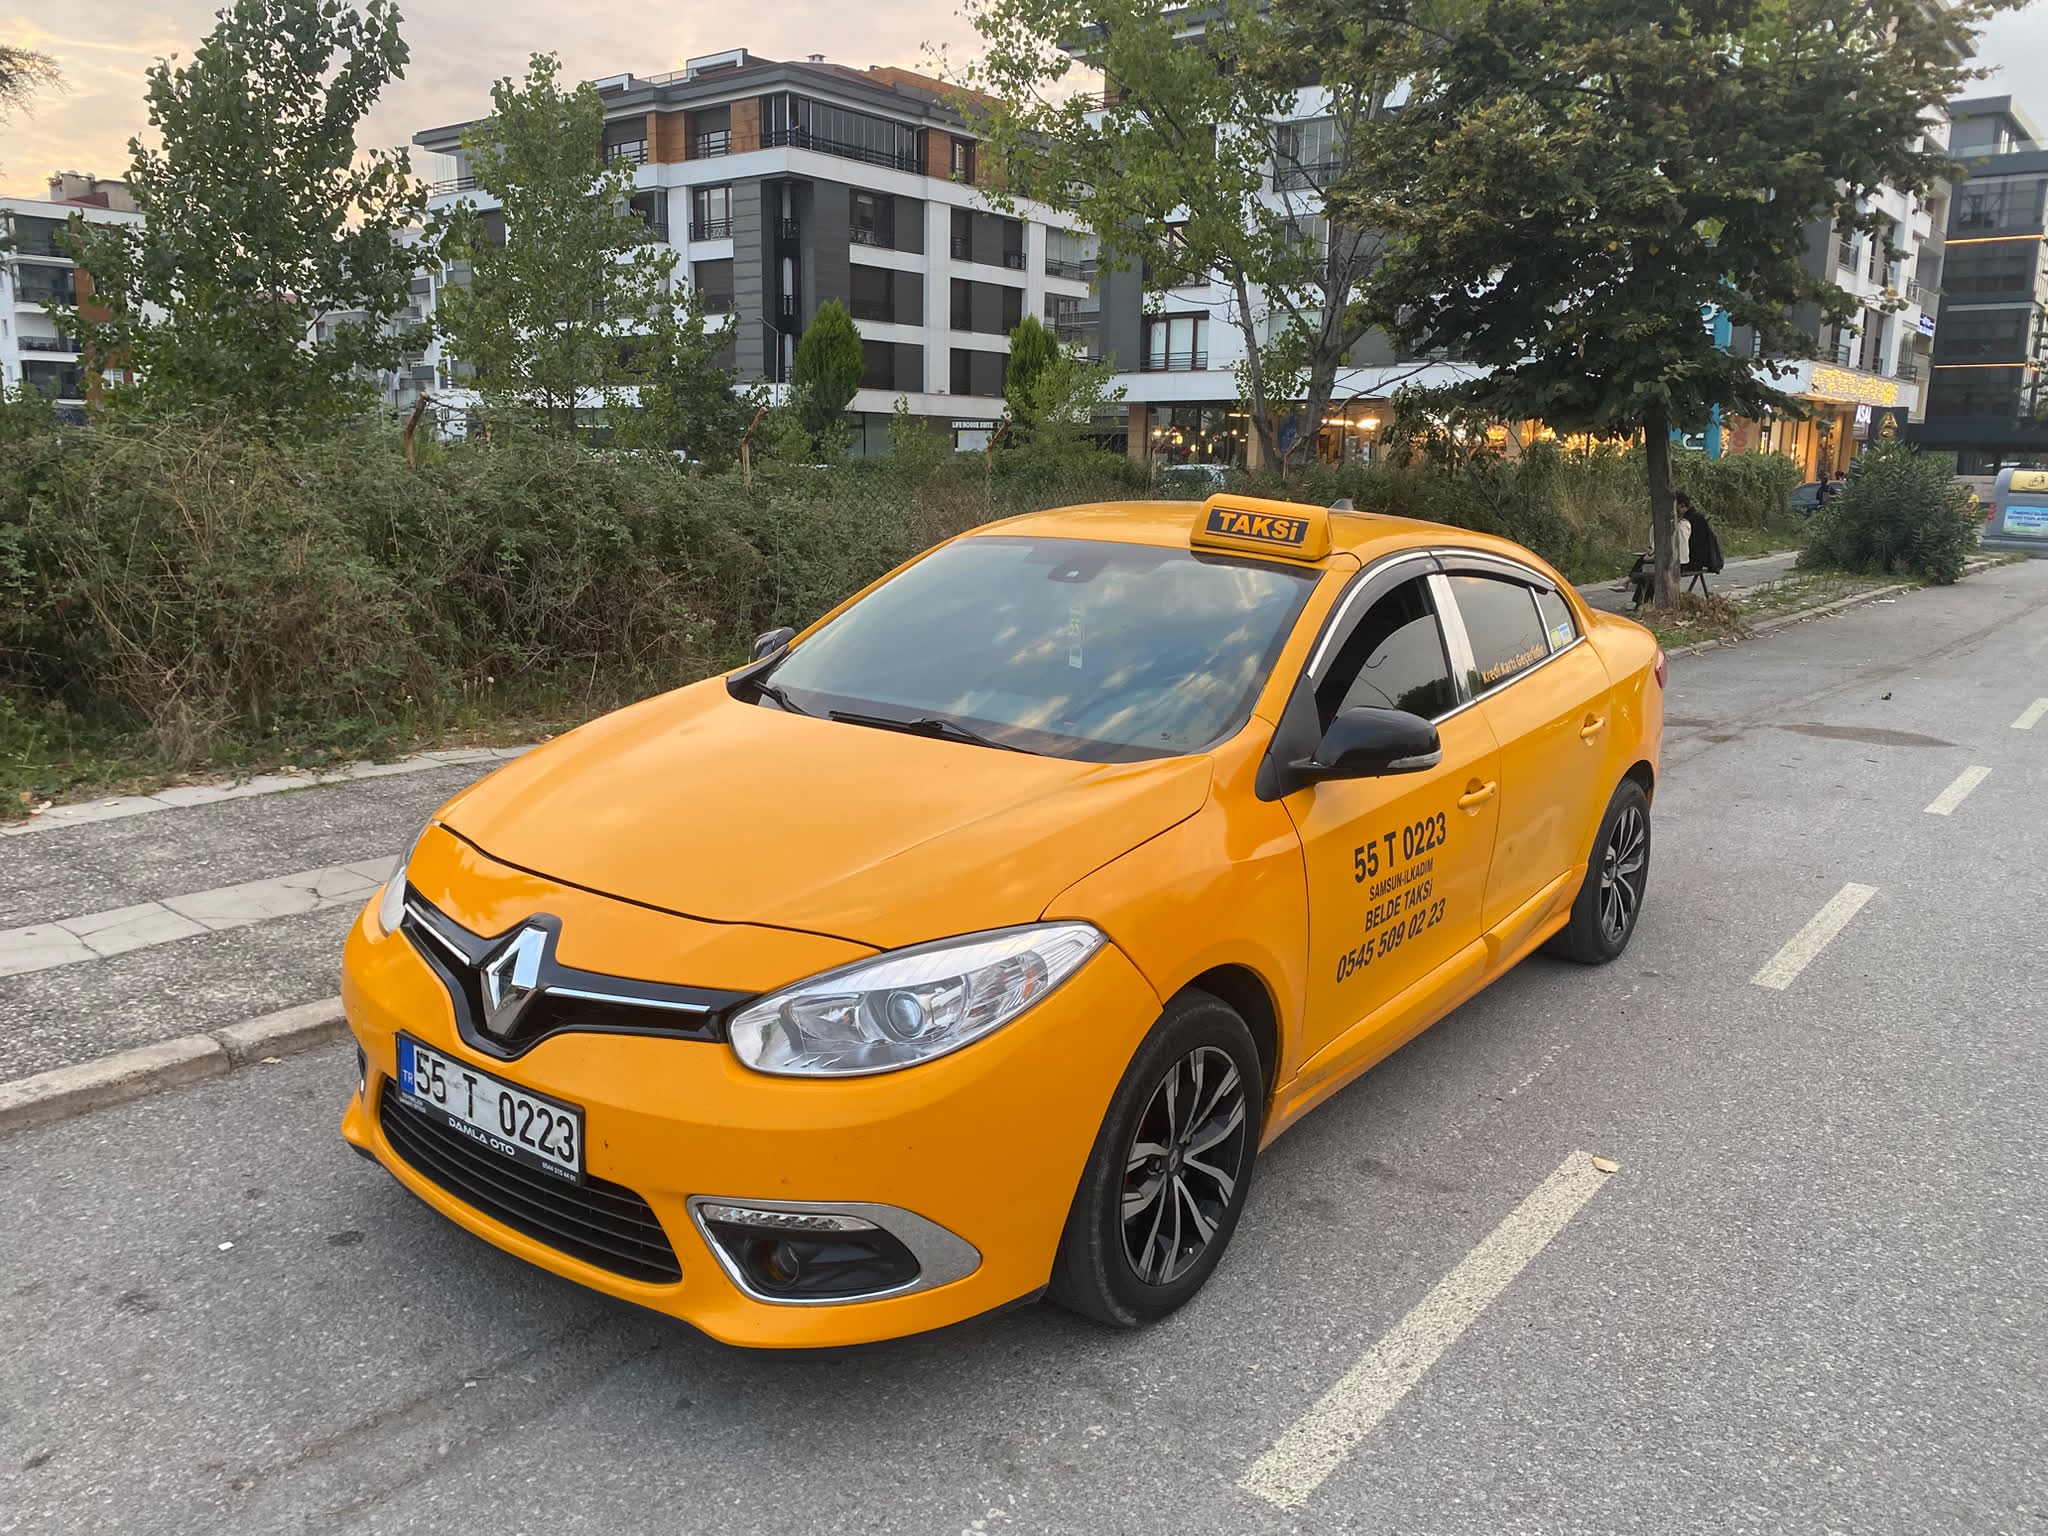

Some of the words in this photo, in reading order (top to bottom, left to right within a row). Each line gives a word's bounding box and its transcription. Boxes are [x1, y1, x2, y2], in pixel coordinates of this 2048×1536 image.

[1481, 662, 1500, 685] Kredi
[1354, 840, 1379, 884] 55
[1384, 831, 1397, 868] T
[1403, 812, 1447, 861] 0223
[1365, 895, 1402, 933] BELDE
[1336, 937, 1375, 984] 0545
[1377, 921, 1406, 959] 509
[1407, 908, 1427, 940] 02
[1427, 897, 1447, 929] 23
[402, 1068, 414, 1086] TR
[415, 1050, 447, 1104] 55
[462, 1072, 478, 1119] T
[499, 1091, 575, 1164] 0223
[448, 1117, 488, 1144] DAMLA
[489, 1138, 515, 1156] OTO
